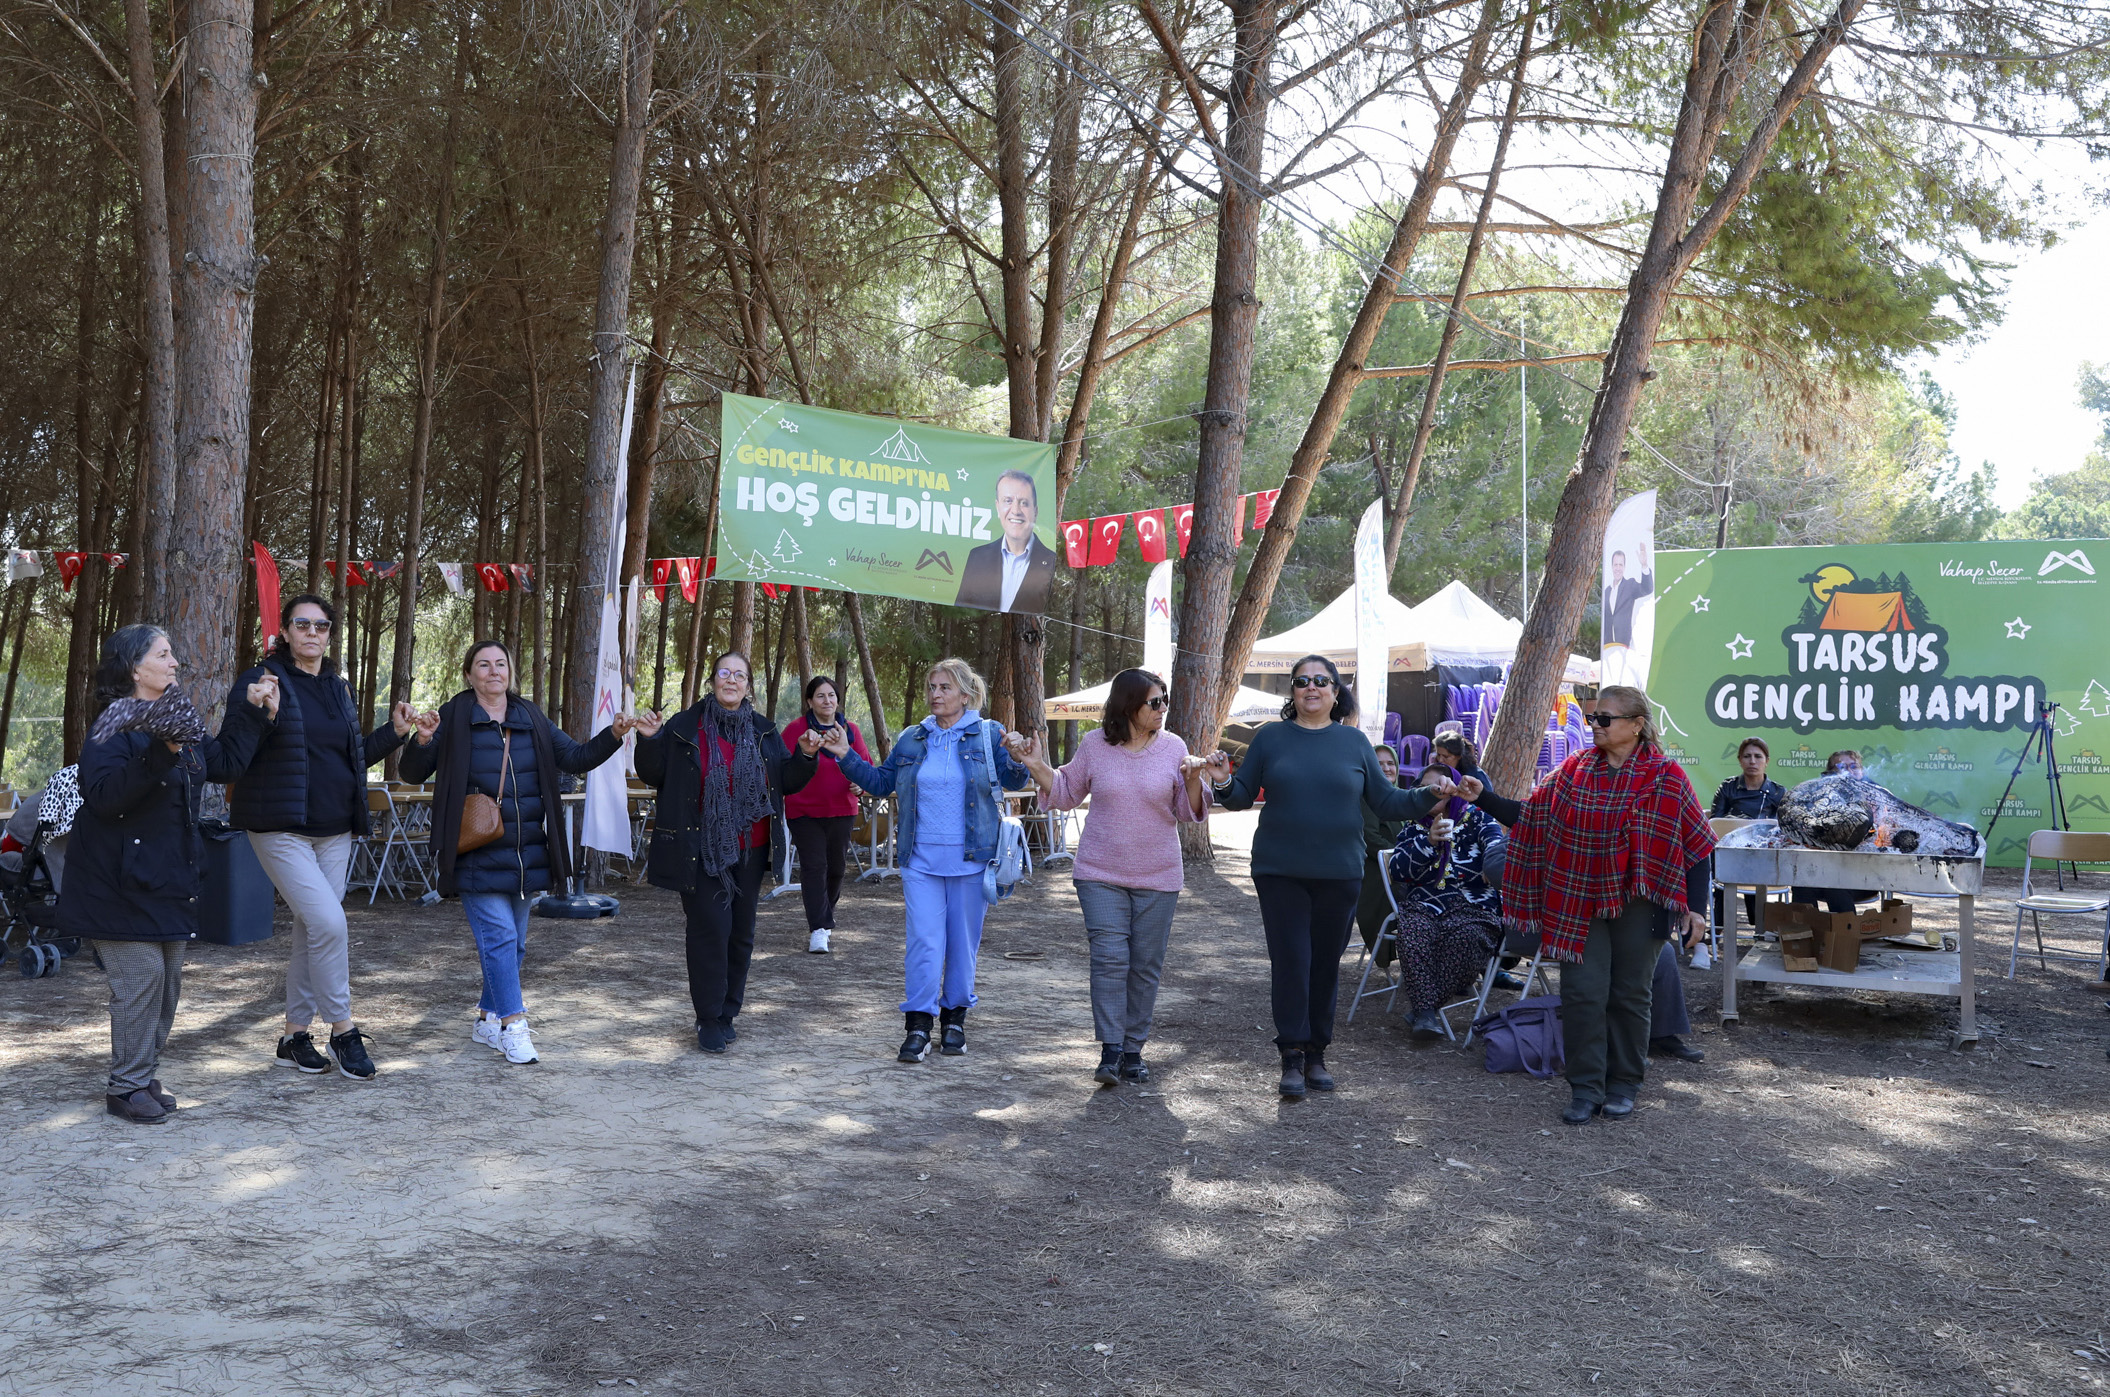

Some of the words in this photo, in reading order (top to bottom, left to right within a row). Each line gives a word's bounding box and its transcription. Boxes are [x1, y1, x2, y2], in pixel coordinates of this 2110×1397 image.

[736, 476, 820, 527] HOŞ
[828, 487, 992, 540] GELDİNİZ
[846, 547, 876, 571] Vahap
[1939, 559, 1984, 584] Vahap
[1987, 560, 2024, 577] Seçer
[1791, 632, 1939, 673] TARSUS
[1256, 660, 1284, 668] MERSİN
[1335, 660, 1357, 668] BELED
[1714, 676, 1876, 727] GENÇLİK
[1899, 684, 2035, 724] KAMPI
[1664, 749, 1685, 757] ARSUS
[1791, 750, 1816, 759] TARSUS
[1928, 753, 1956, 762] TARSUS
[1778, 758, 1806, 767] GENÇLİK
[1808, 759, 1829, 768] KAMP
[2072, 756, 2101, 765] TARSUS
[2057, 764, 2089, 773] GENÇLİK
[2092, 766, 2110, 774] KAM
[1981, 807, 2013, 817] GENLİK
[2016, 809, 2041, 818] KAMPI
